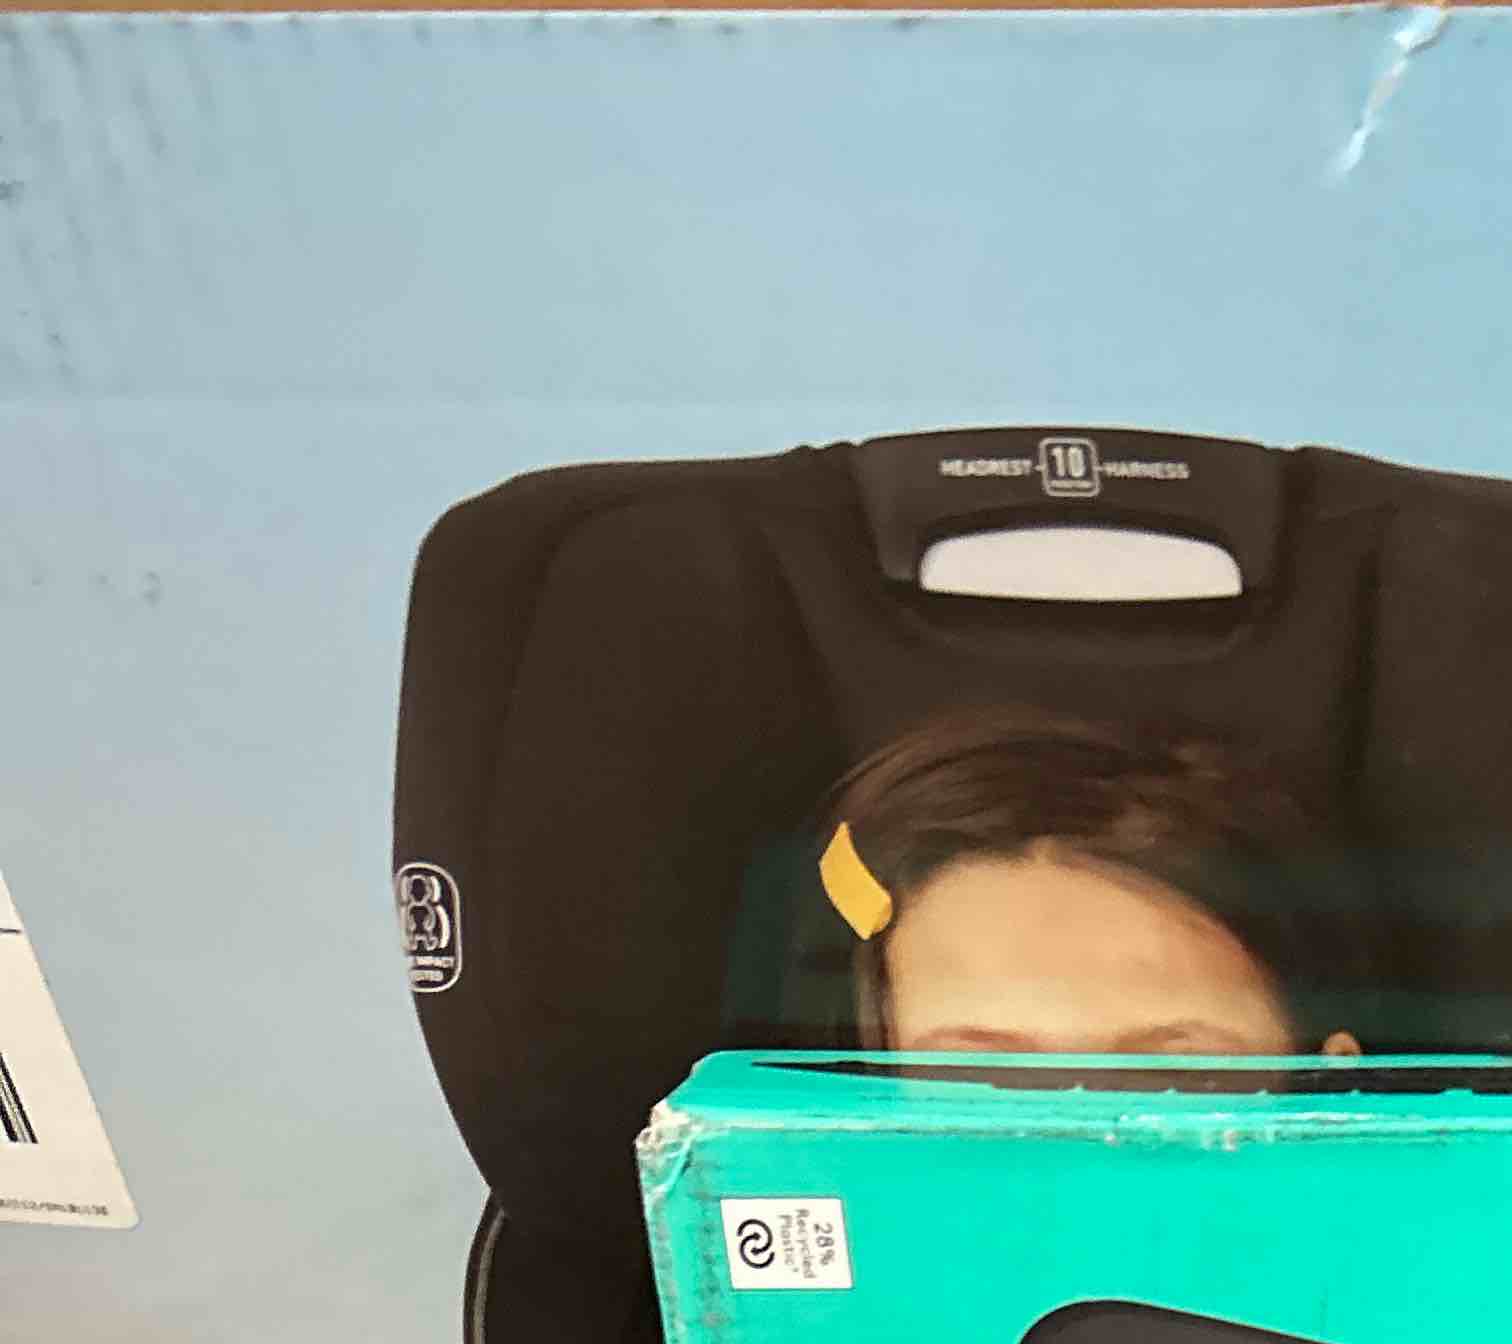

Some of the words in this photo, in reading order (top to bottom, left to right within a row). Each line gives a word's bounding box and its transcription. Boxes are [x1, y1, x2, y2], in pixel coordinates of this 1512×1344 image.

[1051, 447, 1085, 478] 10
[794, 1208, 817, 1280] Recycled
[813, 1221, 834, 1268] 28%
